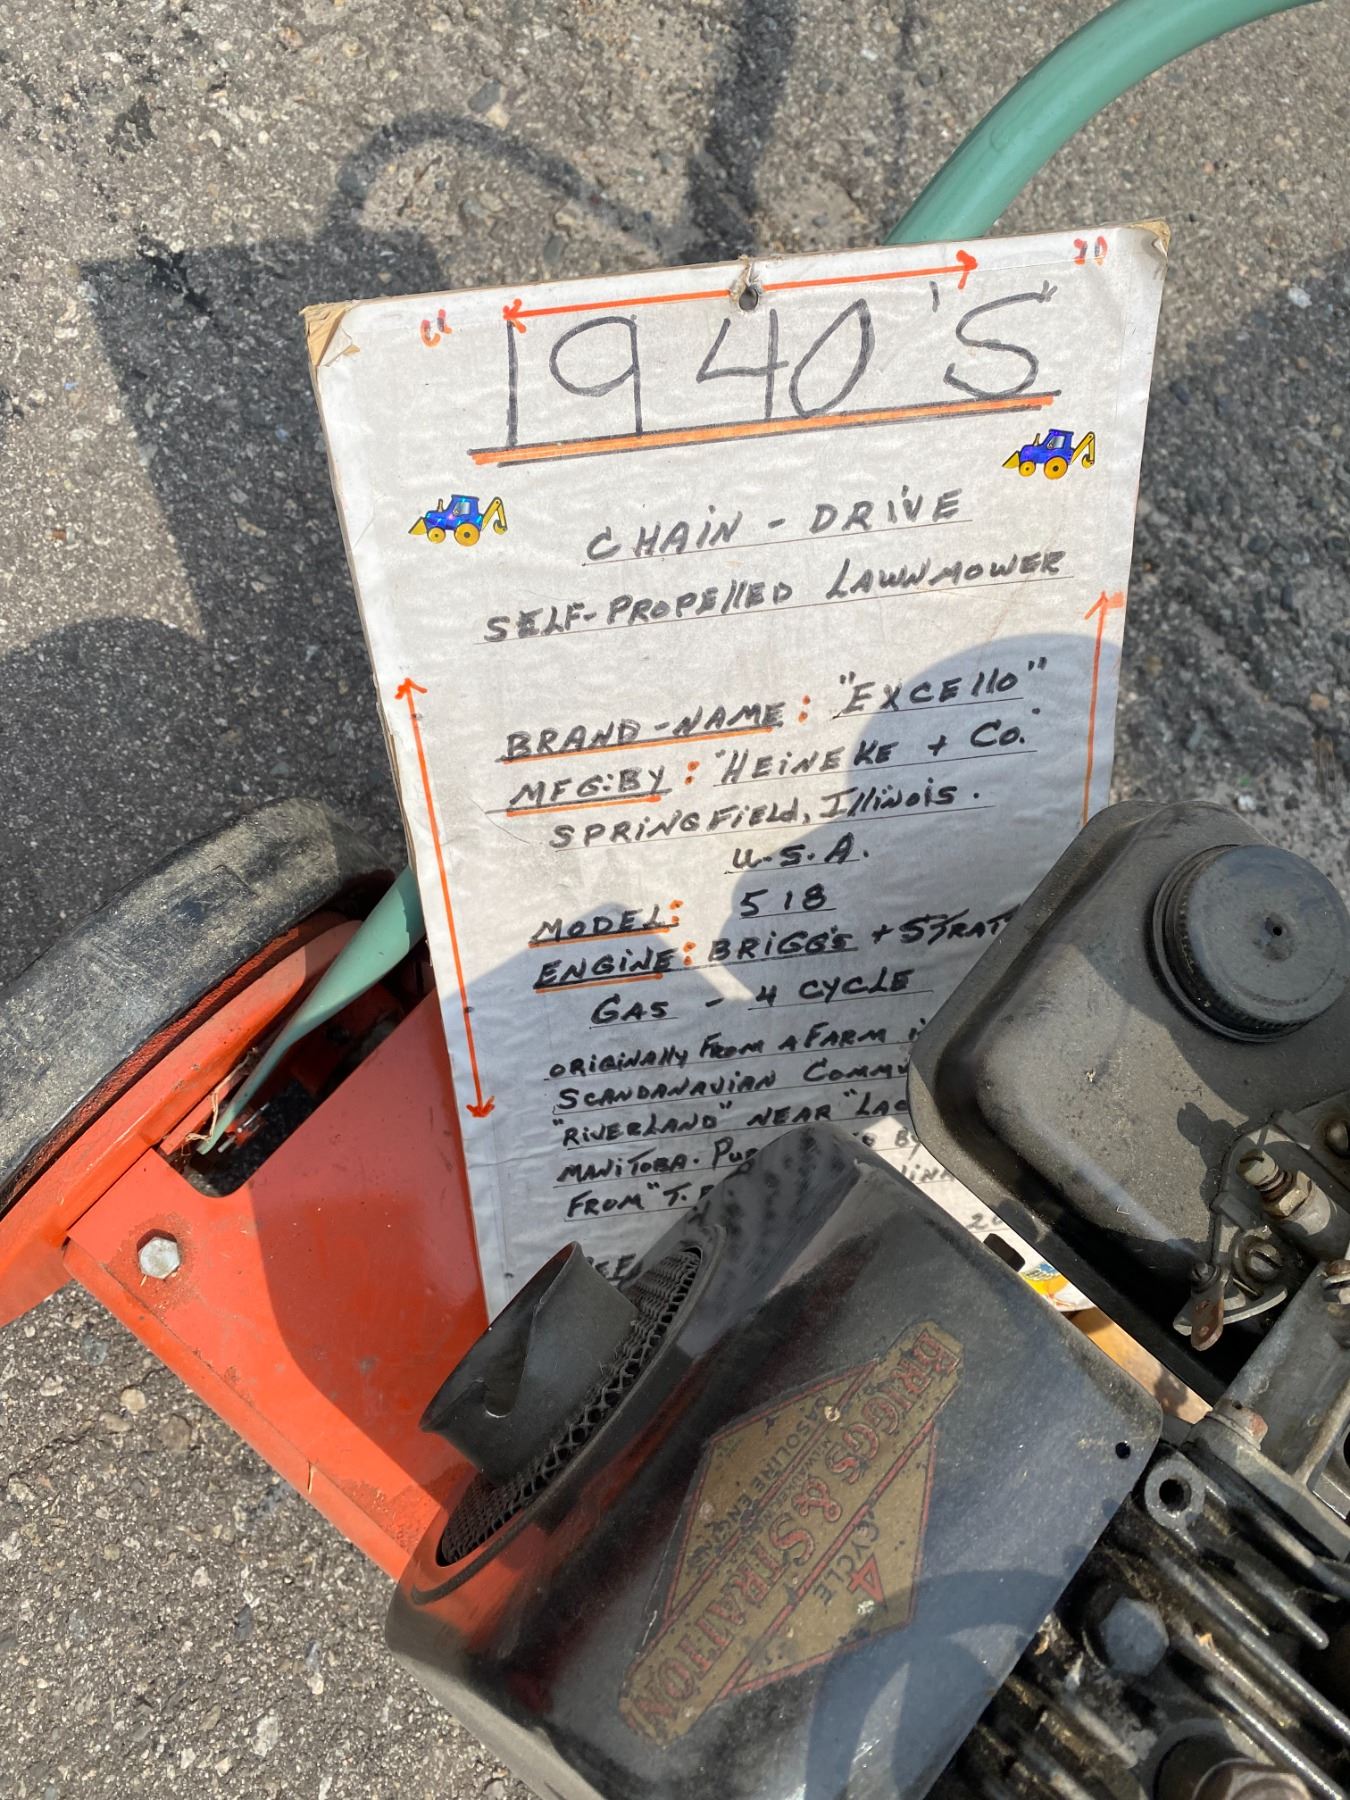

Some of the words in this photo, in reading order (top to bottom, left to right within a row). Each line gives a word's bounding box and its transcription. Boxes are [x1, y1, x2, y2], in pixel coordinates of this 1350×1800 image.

[825, 550, 1066, 600] LAWNMOWER
[927, 734, 947, 757] +
[740, 882, 827, 919] 518
[871, 923, 894, 944] +
[590, 992, 670, 1025] GAS
[755, 984, 778, 1008] 4
[798, 966, 915, 1004] CYCLE
[803, 1021, 887, 1048] FARM
[746, 1103, 833, 1127] NEAR
[566, 1189, 645, 1218] FROM
[827, 1328, 963, 1485] BRIGGS
[799, 1476, 842, 1524] &
[812, 1511, 880, 1607] CYCLE
[846, 1553, 888, 1610] 4
[623, 1512, 816, 1742] STRATTON
